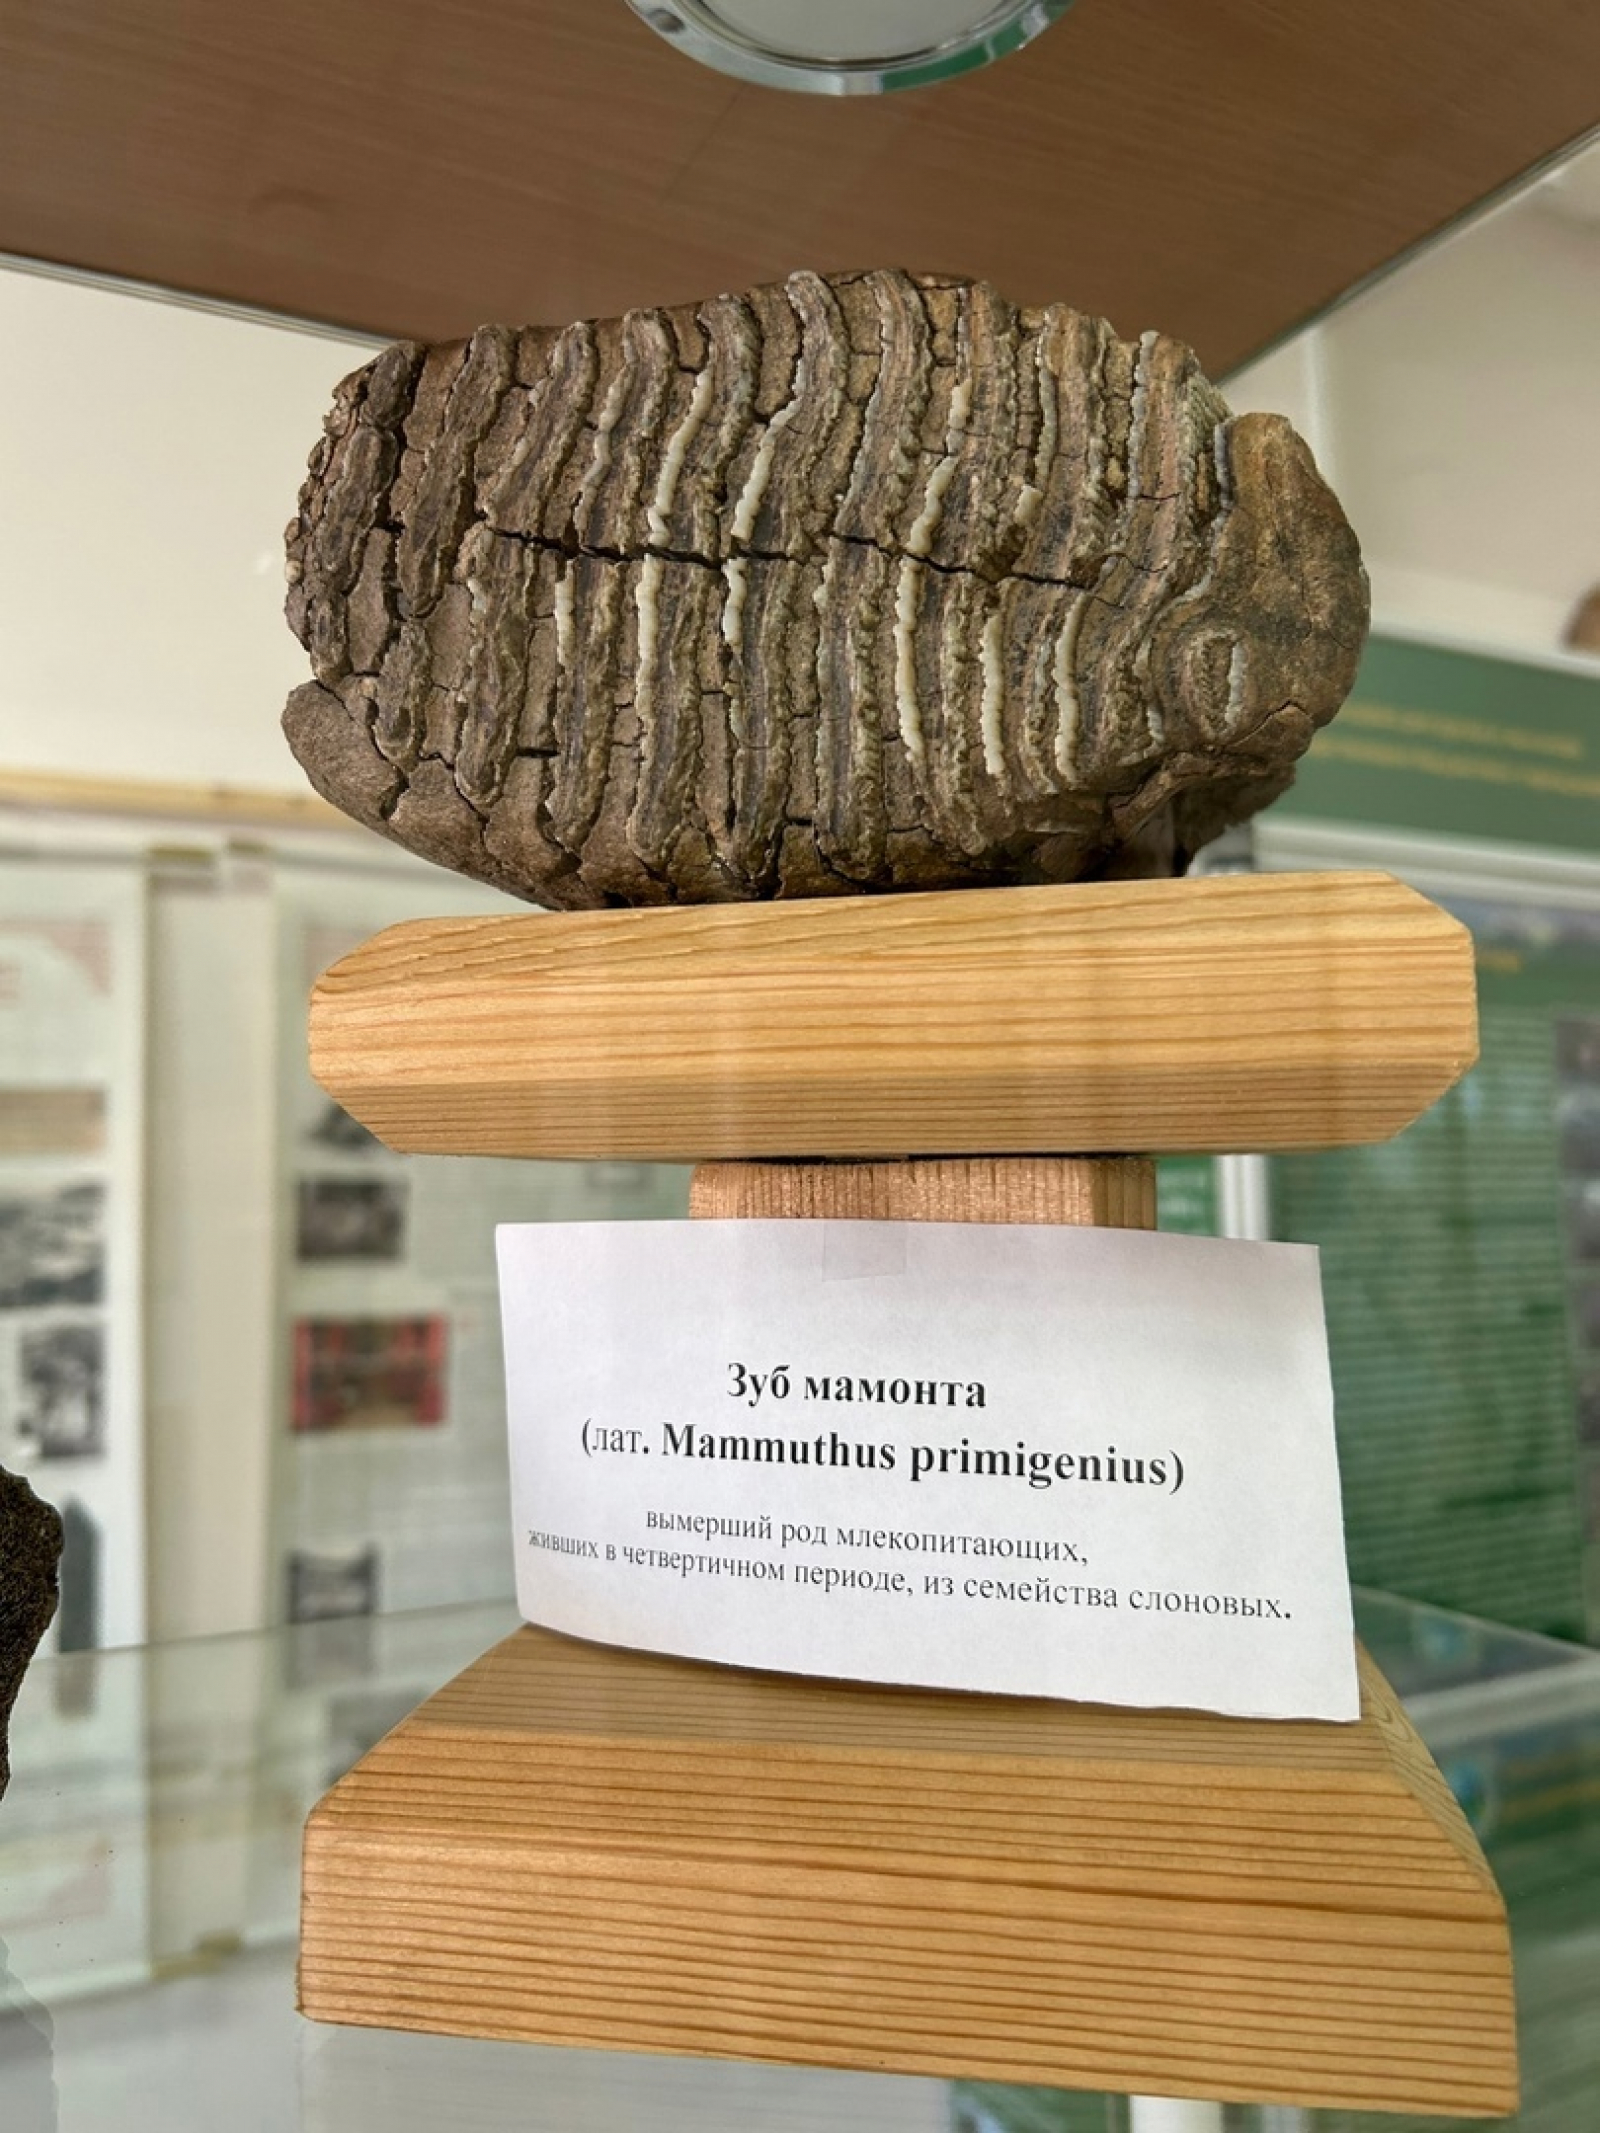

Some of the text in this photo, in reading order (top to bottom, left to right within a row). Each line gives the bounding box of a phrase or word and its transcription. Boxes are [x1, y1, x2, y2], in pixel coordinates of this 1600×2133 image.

[727, 1363, 986, 1408] Зуб мамонта
[582, 1418, 1183, 1495] (лат. Mammuthus primigenius)
[646, 1511, 1087, 1566] вымерший род млекопитающих,
[529, 1530, 1290, 1619] живших в четвертичном периоде, из семейства слоновых.
